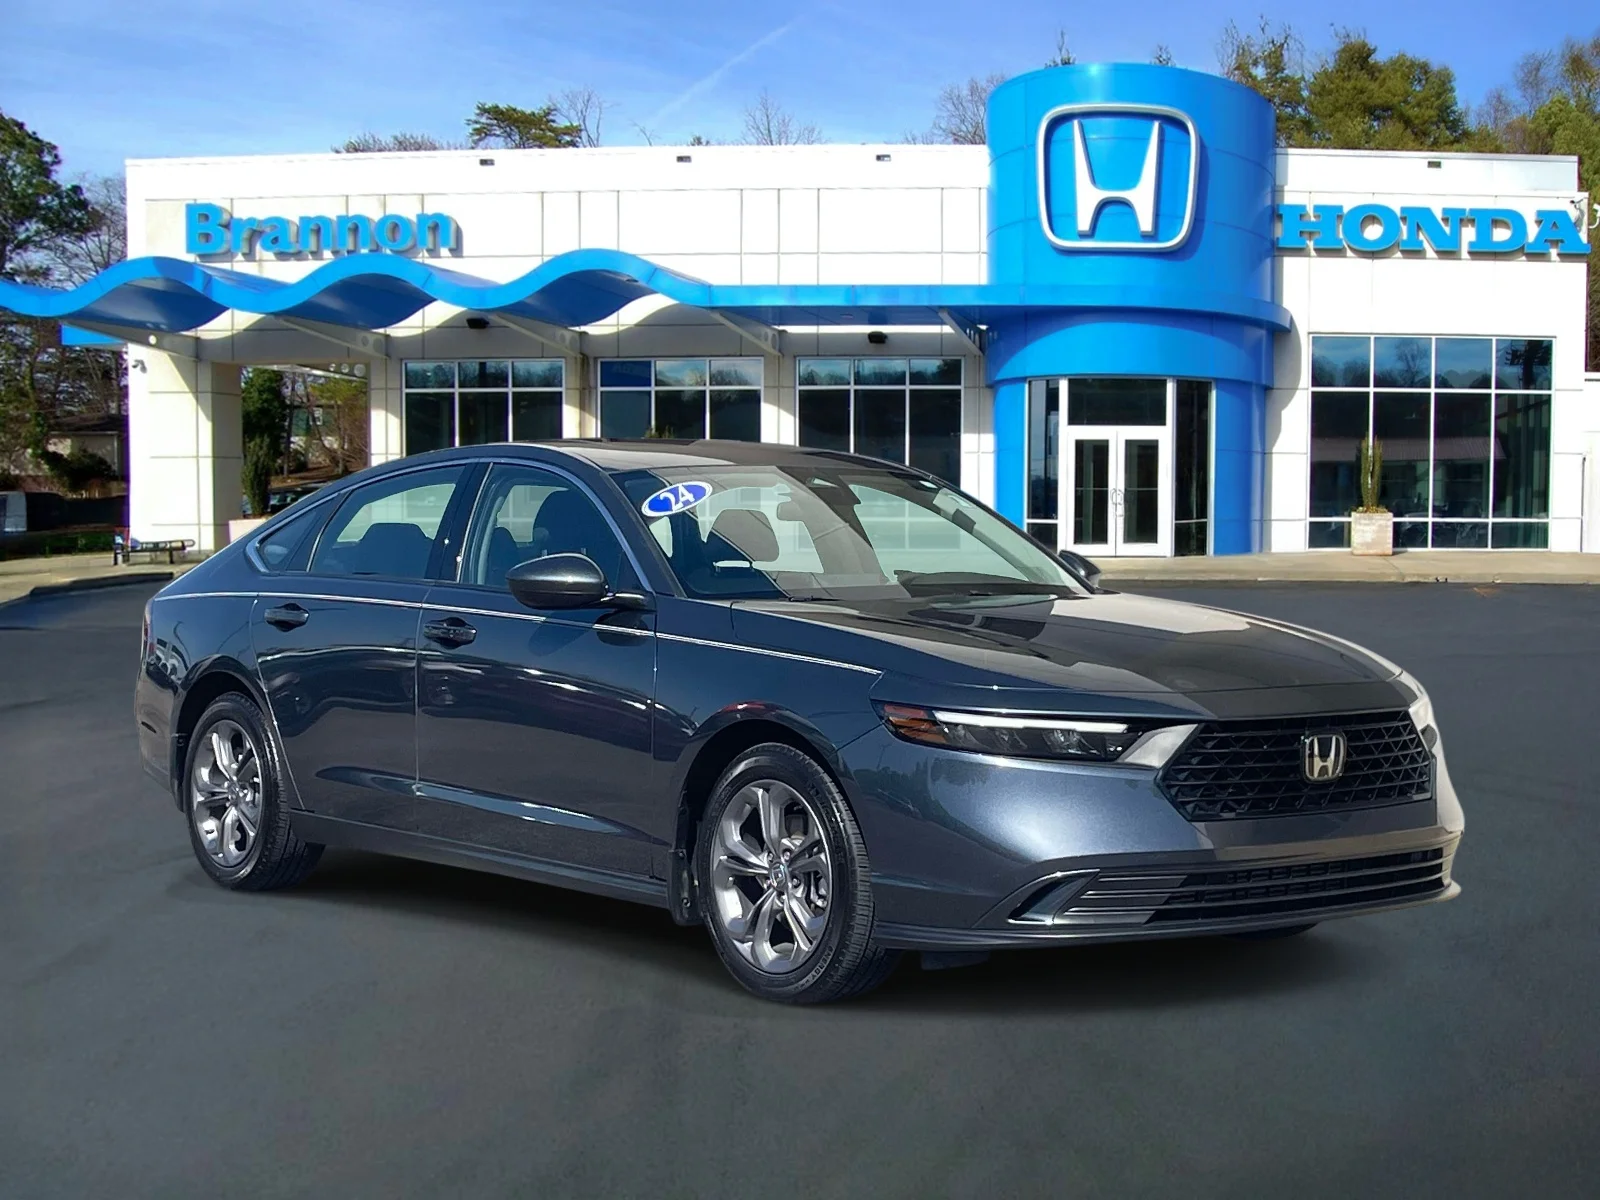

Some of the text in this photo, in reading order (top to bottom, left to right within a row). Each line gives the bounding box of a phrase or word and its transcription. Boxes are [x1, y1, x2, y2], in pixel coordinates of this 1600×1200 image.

[185, 203, 458, 255] Brannon
[1276, 203, 1591, 254] HONDA
[659, 484, 696, 512] 24
